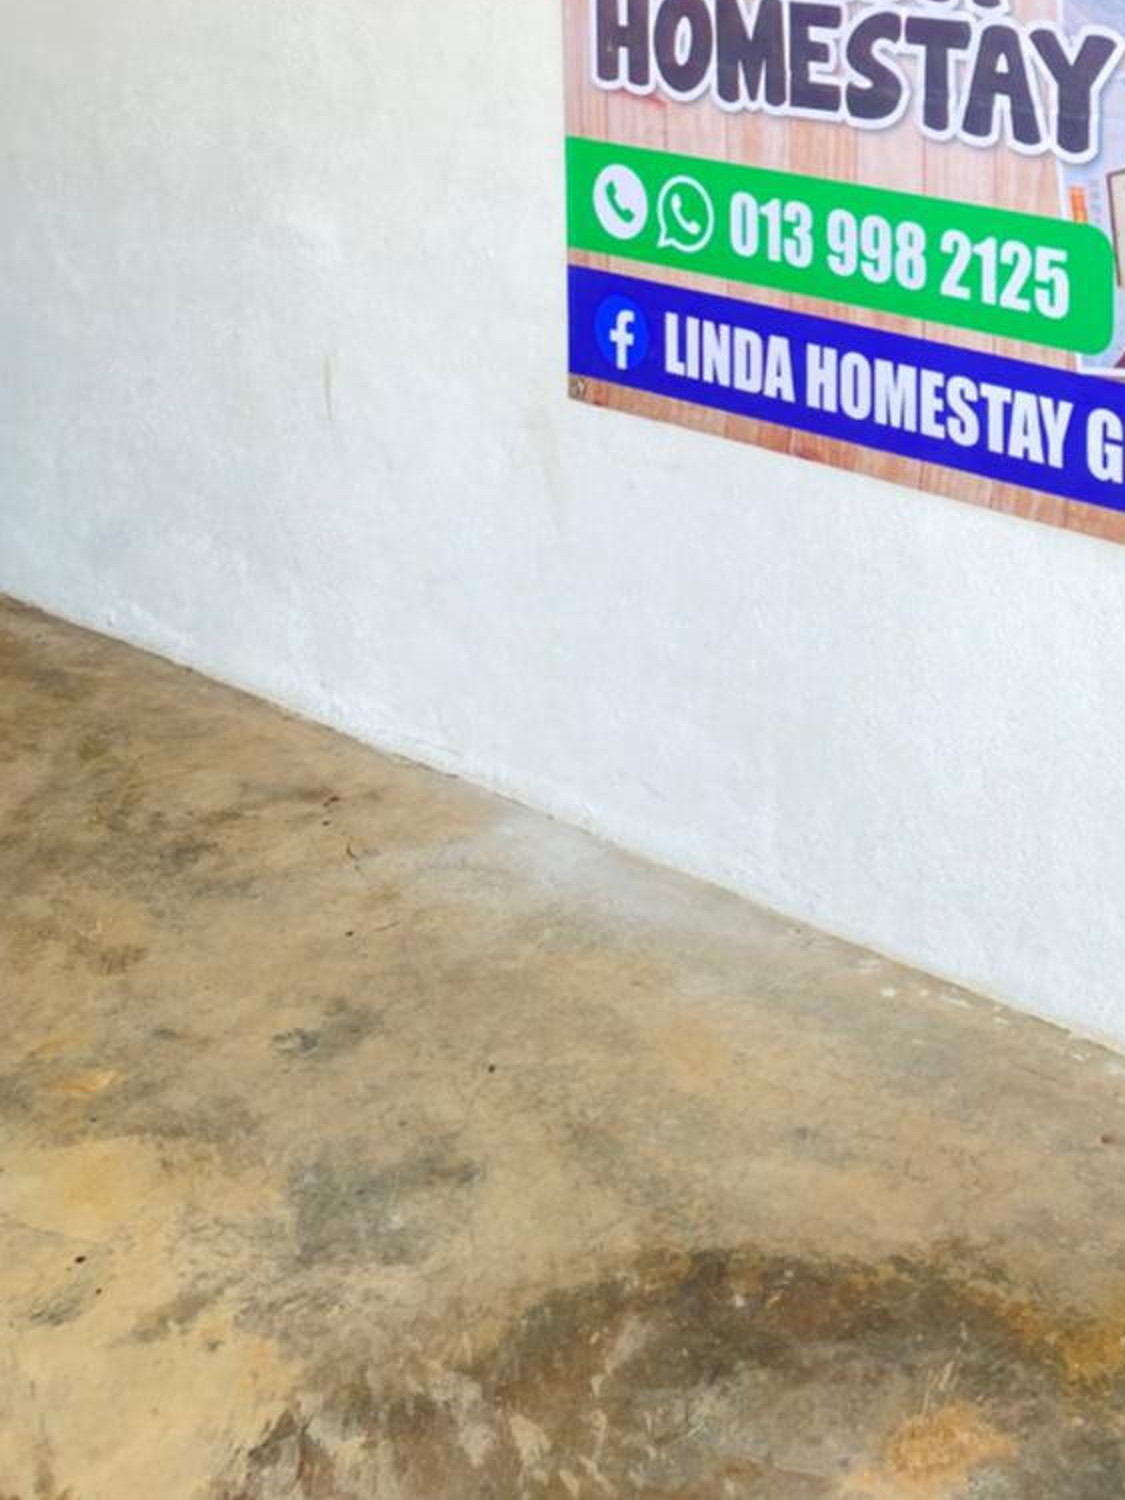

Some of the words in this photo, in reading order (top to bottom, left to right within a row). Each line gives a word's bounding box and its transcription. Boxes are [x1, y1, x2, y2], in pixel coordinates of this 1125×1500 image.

[729, 191, 813, 268] 013
[826, 208, 927, 291] 998
[940, 229, 1070, 319] 2125
[664, 311, 796, 402] LINDA
[805, 343, 1073, 469] HOMESTAY
